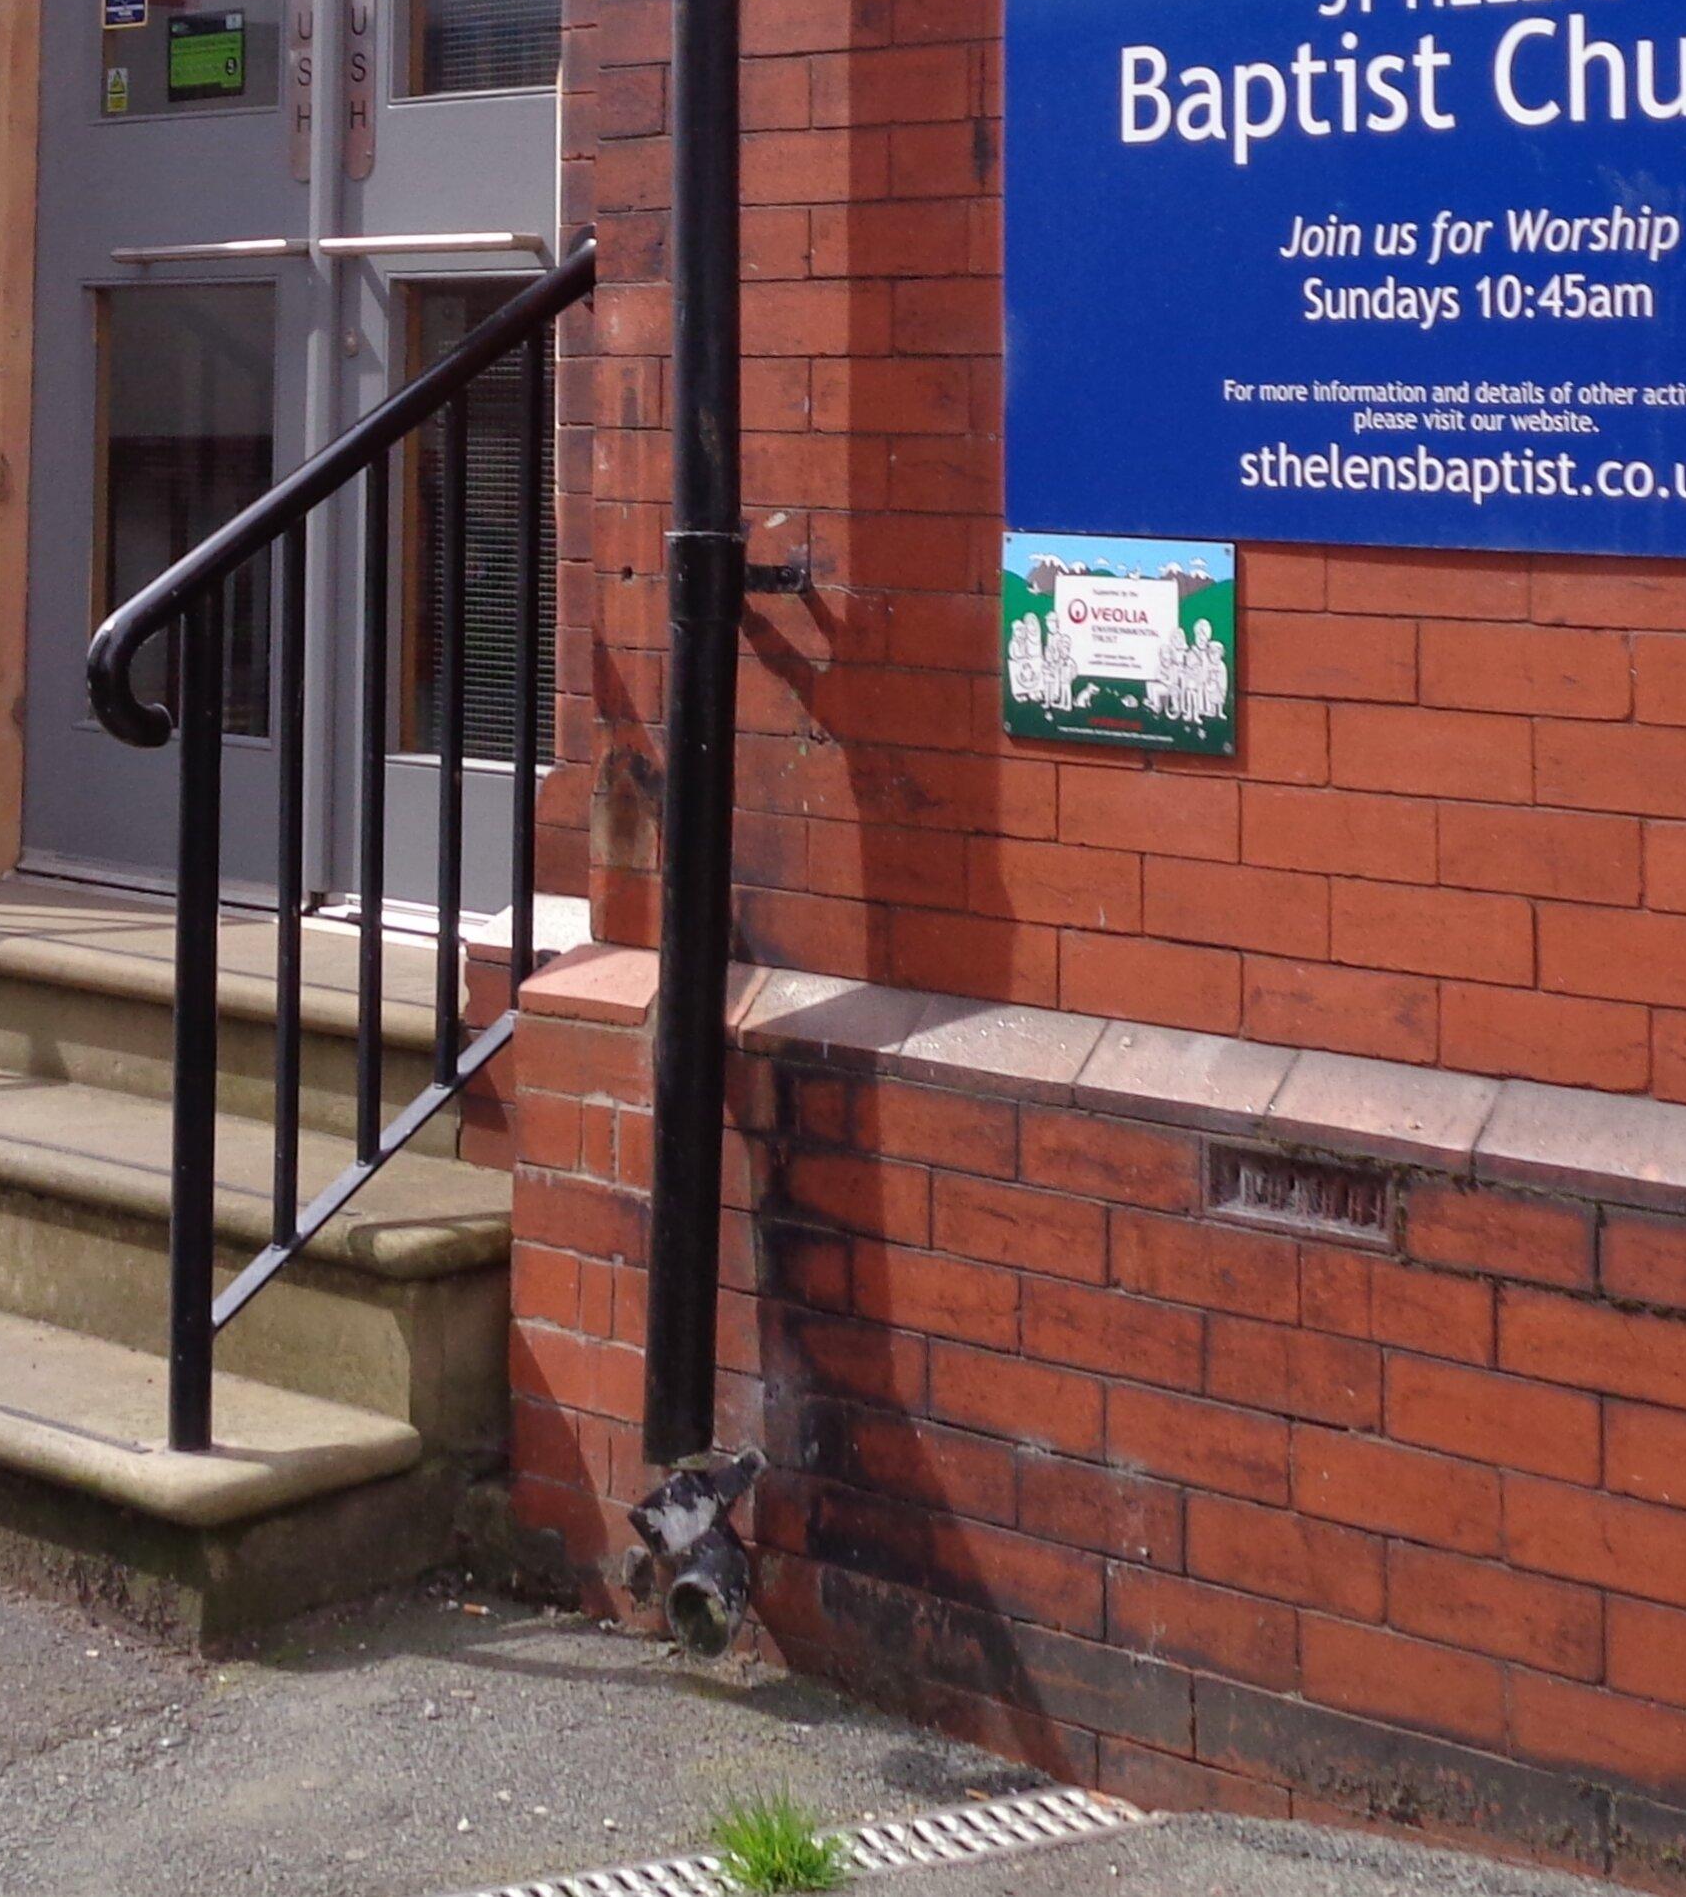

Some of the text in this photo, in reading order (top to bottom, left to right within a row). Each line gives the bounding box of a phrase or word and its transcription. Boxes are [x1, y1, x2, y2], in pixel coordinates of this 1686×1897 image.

[1120, 31, 1456, 165] Baptist
[1279, 203, 1680, 264] Join us for Worship
[1303, 273, 1654, 330] Sundays 10:45am
[1223, 379, 1256, 401] For
[1259, 384, 1309, 402] more
[1312, 379, 1427, 403] information
[1431, 380, 1470, 404] and
[1474, 381, 1545, 405] details
[1549, 381, 1575, 406] of
[1577, 381, 1638, 406] other
[1353, 406, 1600, 434] please visit our website.
[1091, 607, 1148, 624] VEOLIA
